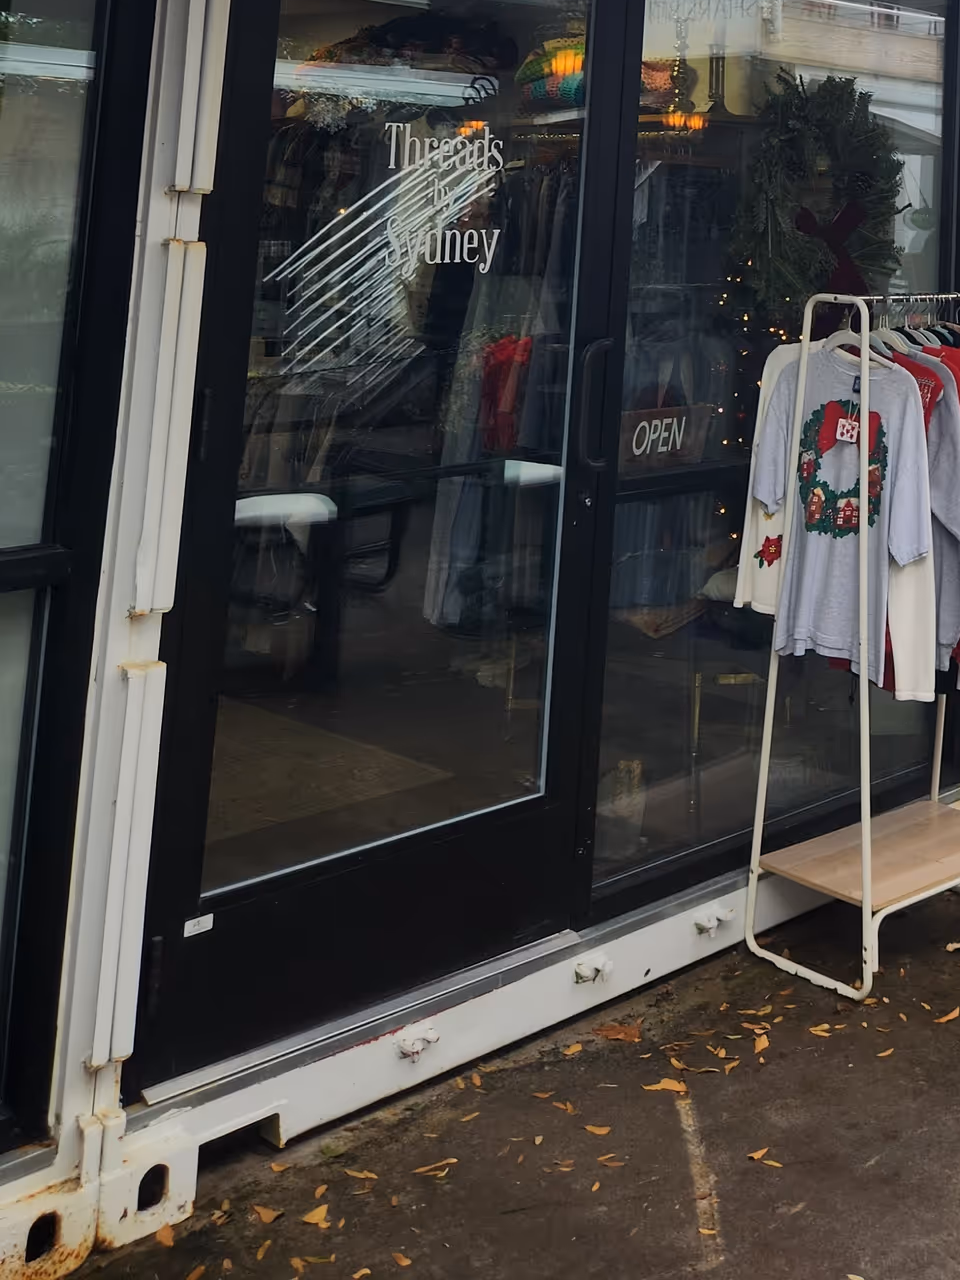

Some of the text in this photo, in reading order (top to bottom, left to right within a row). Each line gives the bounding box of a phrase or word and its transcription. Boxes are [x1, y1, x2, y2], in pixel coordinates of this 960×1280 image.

[385, 122, 504, 172] Threads
[385, 215, 501, 278] Sydney
[632, 416, 687, 456] OPEN
